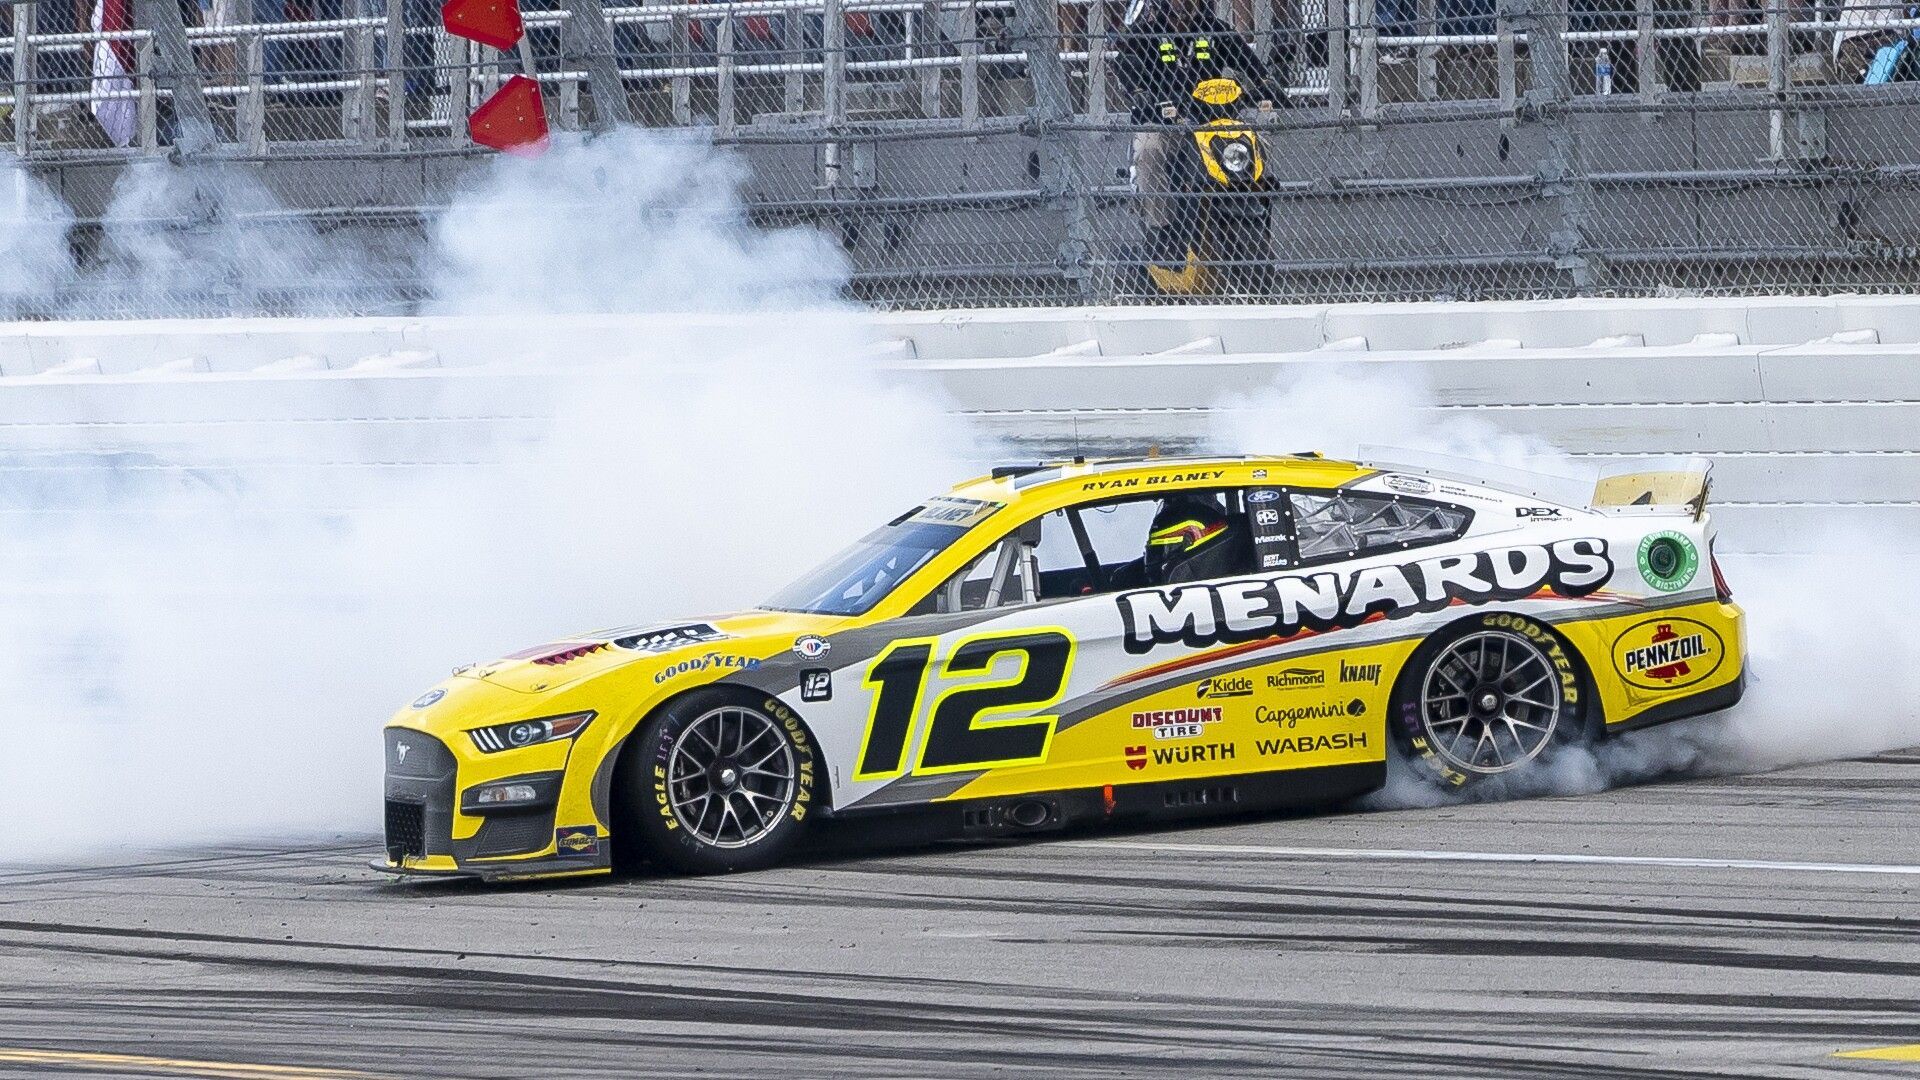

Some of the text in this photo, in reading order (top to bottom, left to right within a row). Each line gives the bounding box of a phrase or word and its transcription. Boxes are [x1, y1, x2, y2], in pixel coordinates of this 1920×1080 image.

[1082, 470, 1225, 491] RYAN BLANEY
[1515, 507, 1562, 517] DEX
[1116, 537, 1615, 654] MENARDS
[1482, 614, 1578, 704] GOODYEAR
[1625, 634, 1708, 673] PENNZOIL
[654, 652, 761, 684] GOODYEAR
[1267, 671, 1324, 687] Richmond
[804, 672, 830, 698] 12
[1213, 677, 1253, 692] Kidde
[852, 625, 1079, 782] 12
[1256, 701, 1345, 729] Capgemini
[1132, 707, 1222, 728] DISCOUNT
[1158, 725, 1198, 737] TIRE
[1255, 732, 1367, 755] WABASH
[764, 699, 814, 821] GOODYEAR
[654, 765, 679, 830] EAGLE
